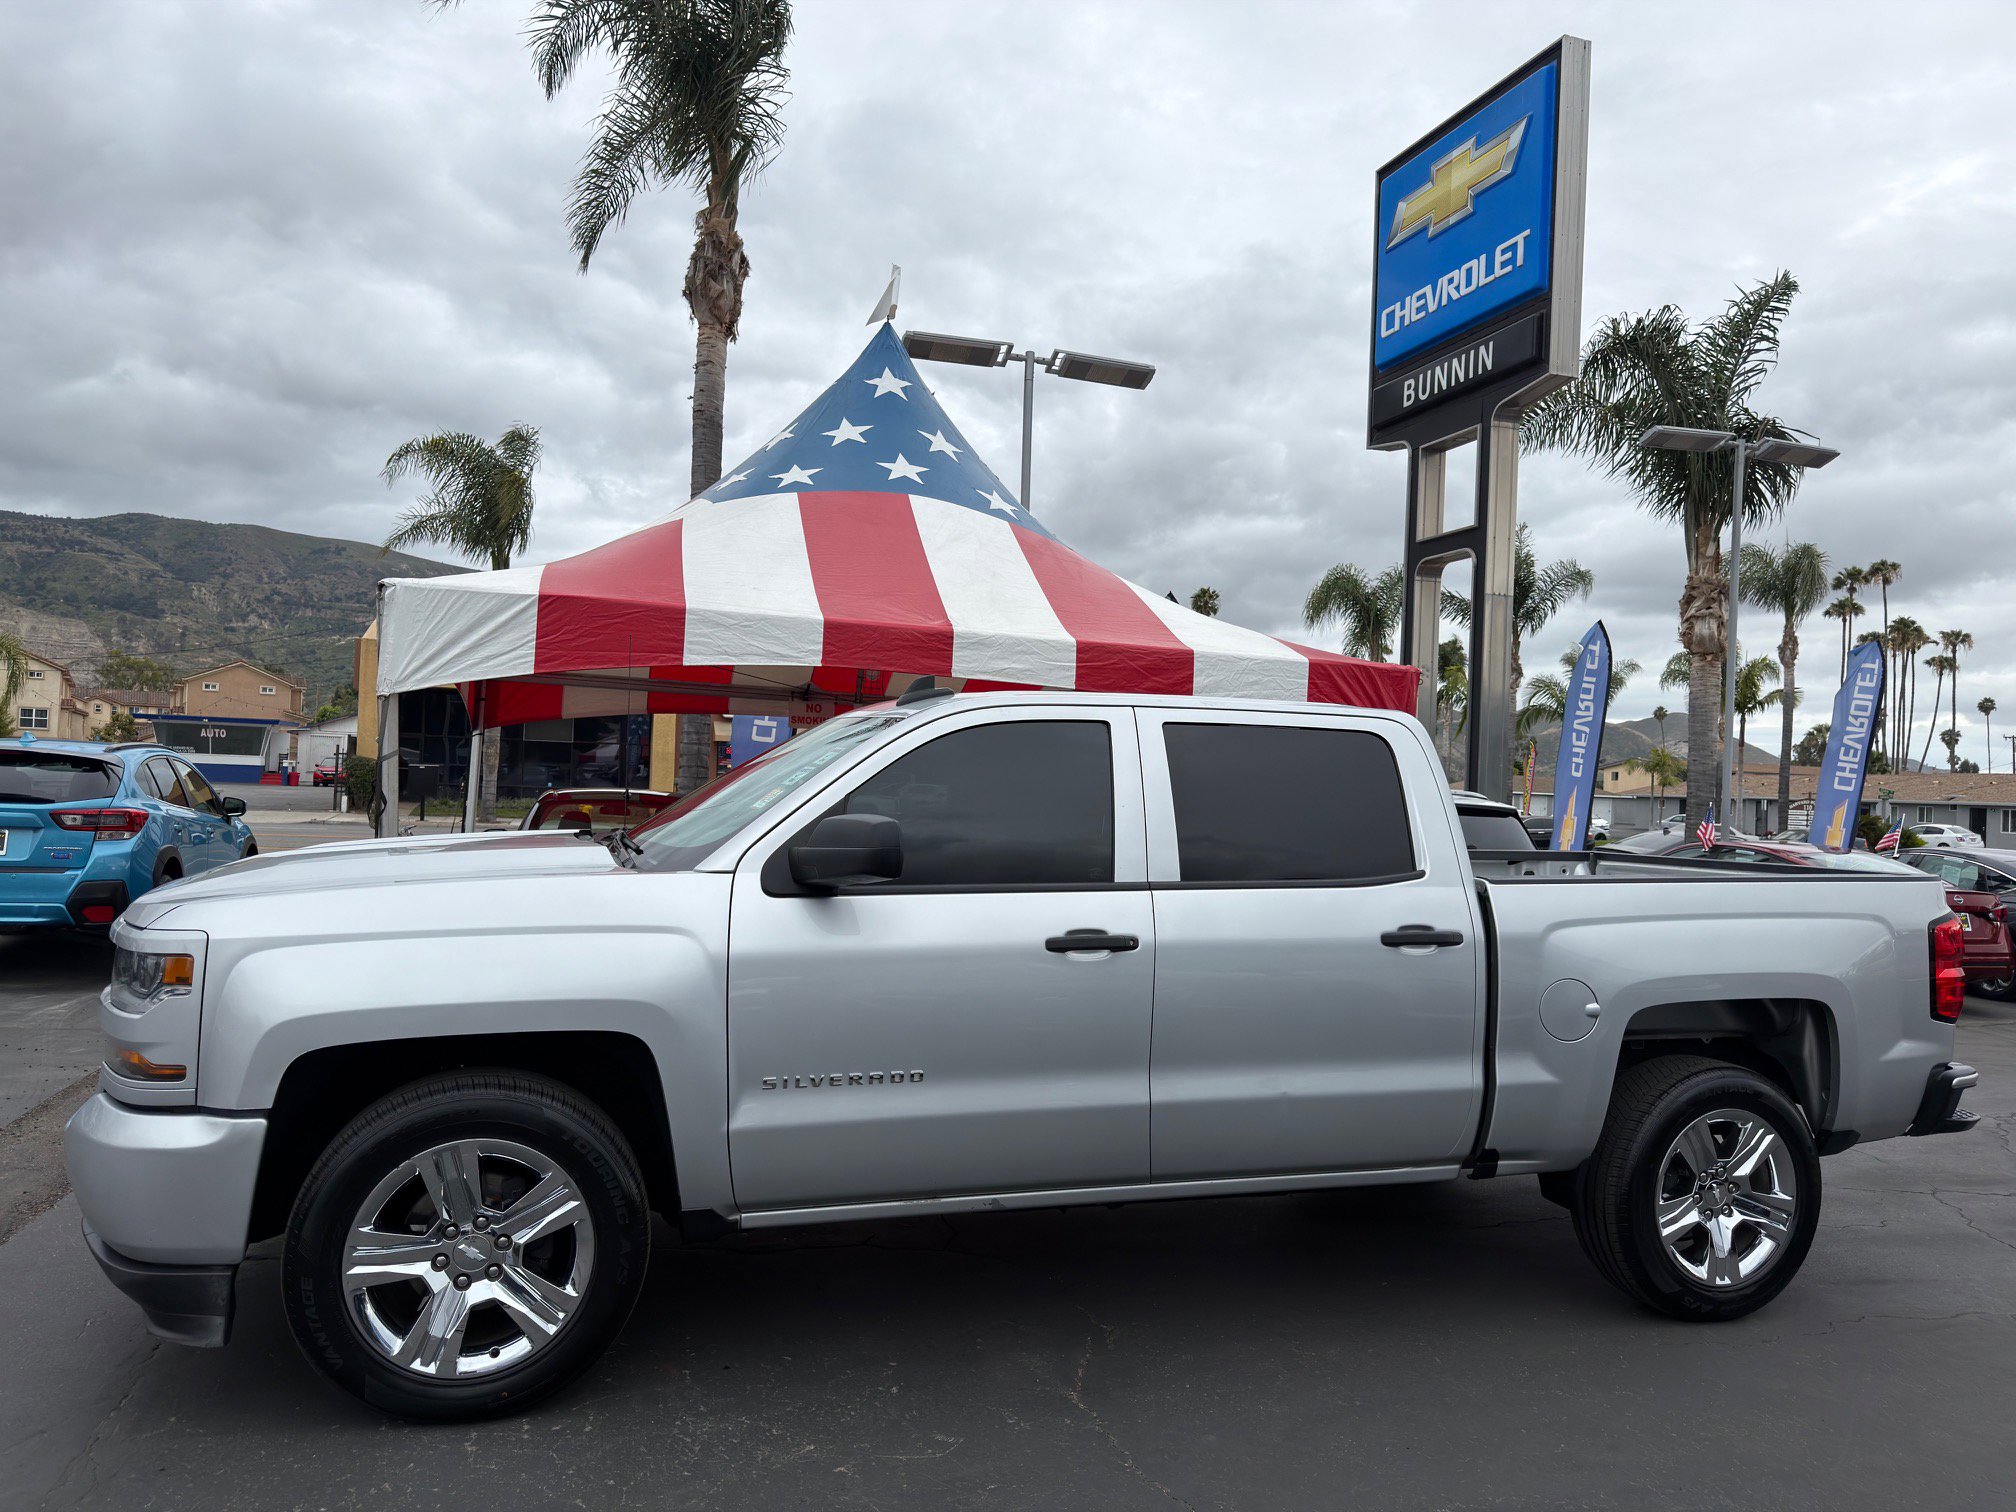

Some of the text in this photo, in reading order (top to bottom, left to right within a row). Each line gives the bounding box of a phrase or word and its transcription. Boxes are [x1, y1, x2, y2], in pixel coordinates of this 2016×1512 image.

[1380, 228, 1532, 339] CHEVROLET
[1402, 340, 1495, 409] BUNNIN
[806, 703, 823, 714] NO
[790, 715, 831, 725] SMOKI
[200, 728, 227, 738] AUTO
[761, 1069, 925, 1090] SILVERADO
